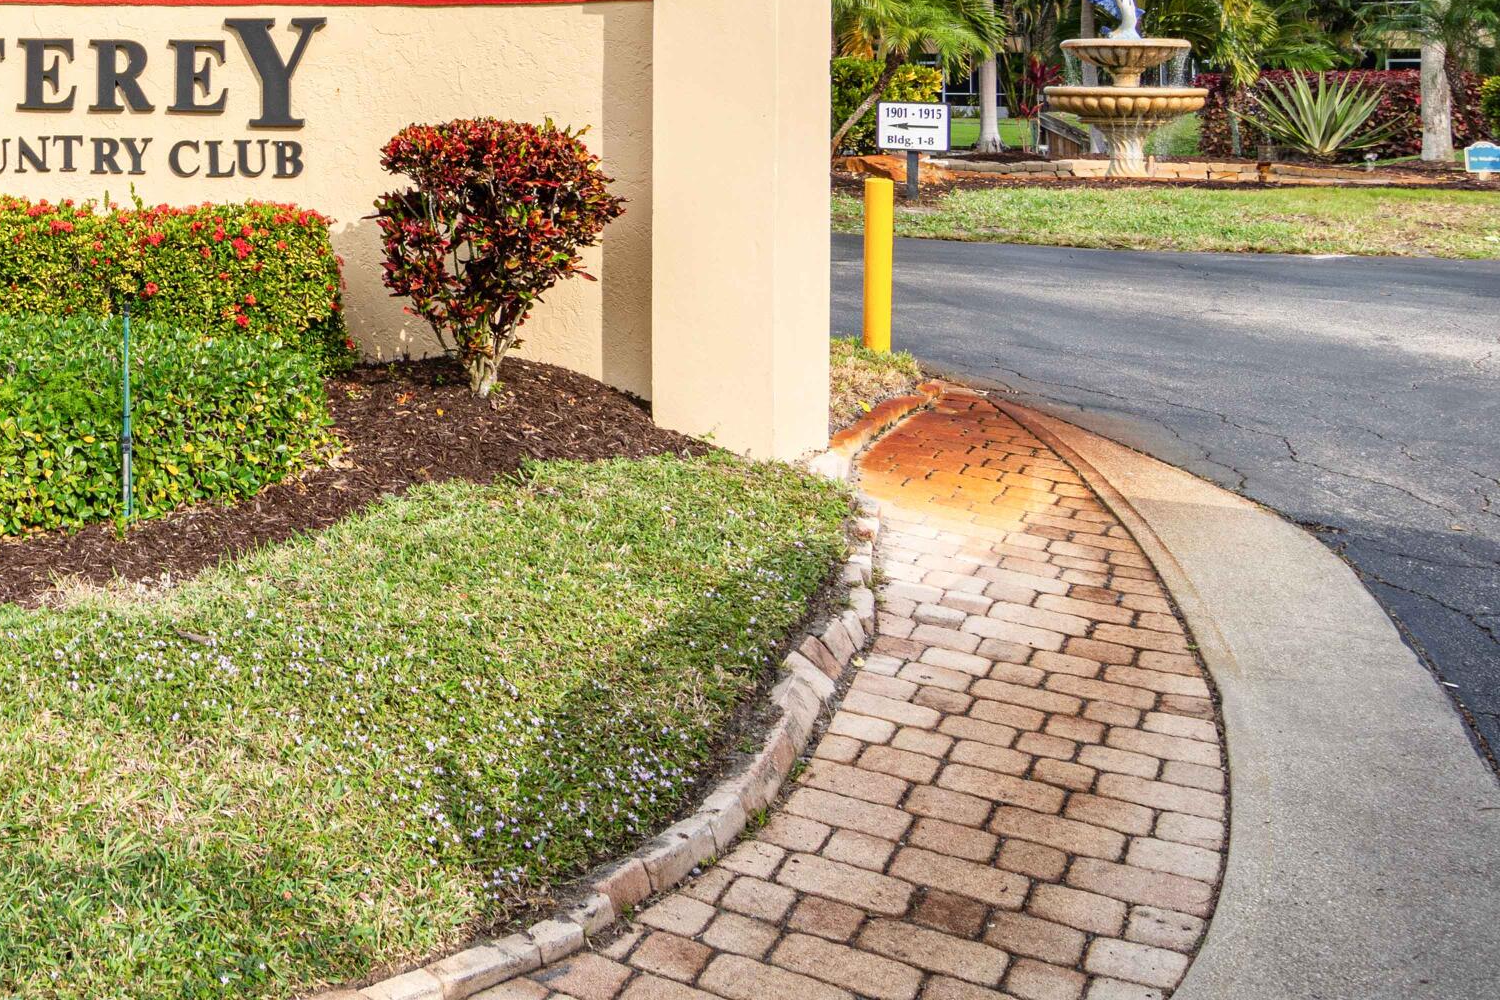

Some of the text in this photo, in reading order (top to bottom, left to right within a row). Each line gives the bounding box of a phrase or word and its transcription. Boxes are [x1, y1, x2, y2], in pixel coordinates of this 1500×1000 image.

[885, 107, 907, 118] 1901
[919, 108, 942, 119] 1915
[887, 135, 934, 147] Bldg. 1-8
[167, 139, 304, 179] CLUB
